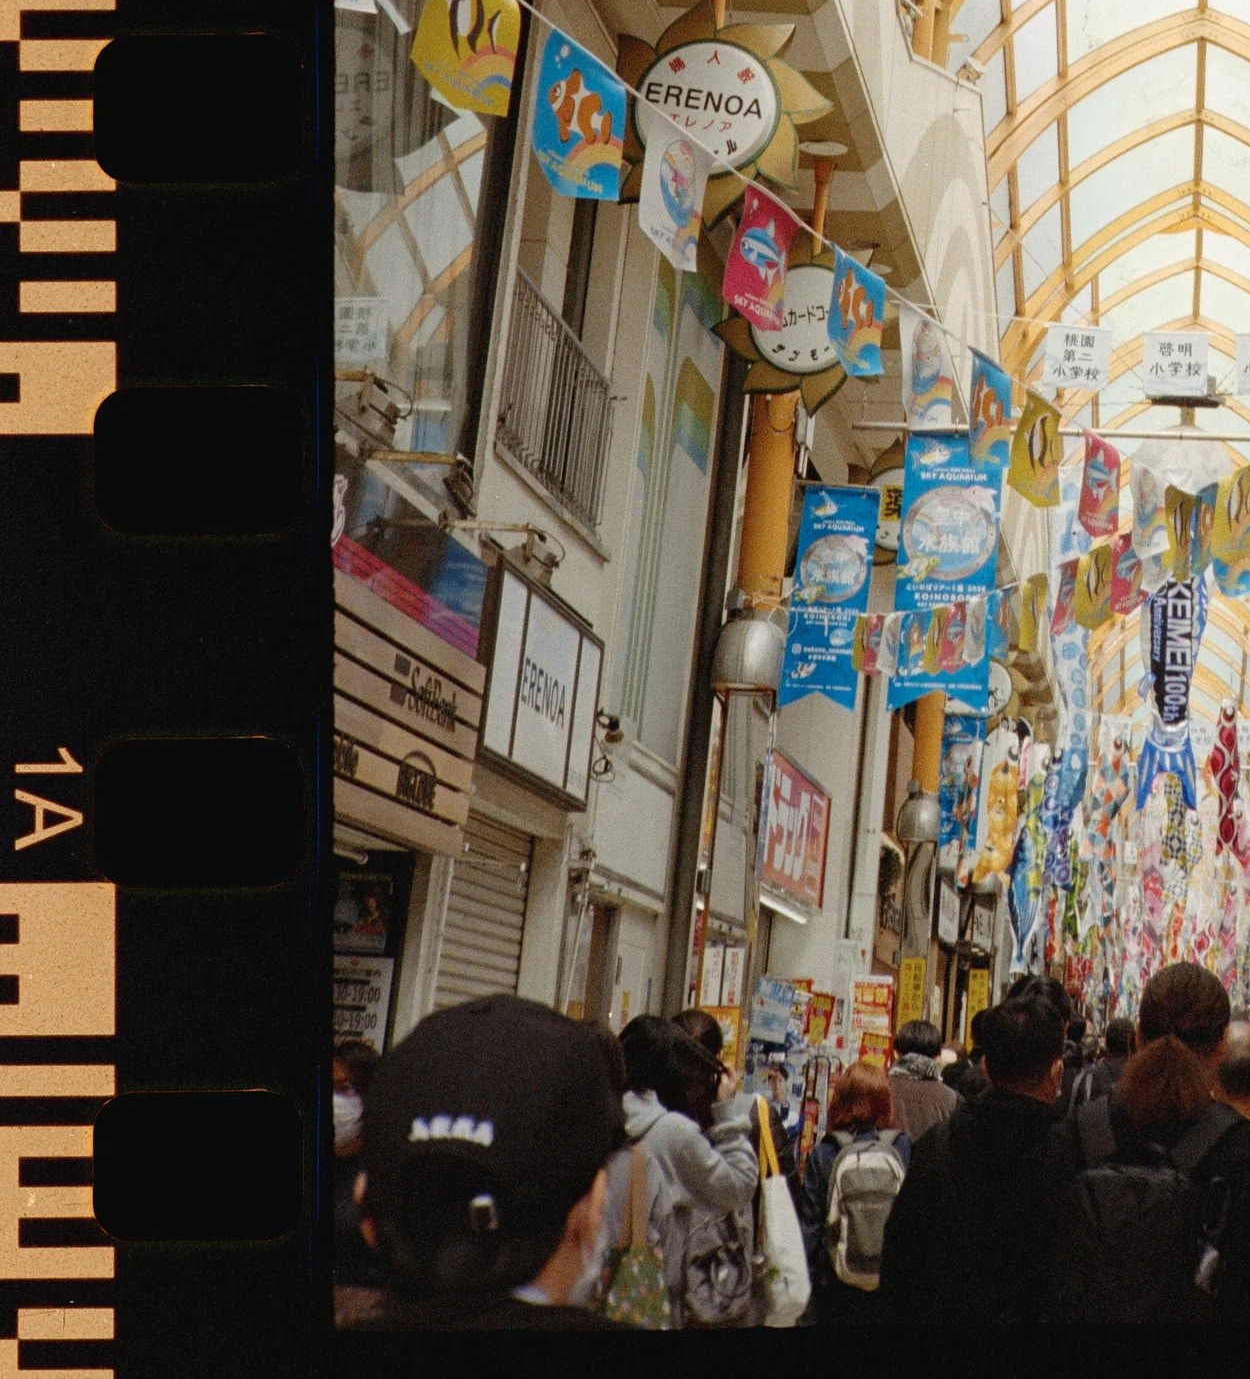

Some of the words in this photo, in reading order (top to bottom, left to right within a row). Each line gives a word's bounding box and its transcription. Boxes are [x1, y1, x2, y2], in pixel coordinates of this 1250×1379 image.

[645, 82, 763, 120] ERENOA
[1063, 333, 1095, 347] 桃園
[771, 343, 831, 361] サンモー
[1063, 349, 1094, 362] 第二
[1159, 341, 1194, 357] 啓明
[1053, 366, 1100, 381] 小学校
[1149, 360, 1202, 377] 小学校
[920, 472, 936, 481] SKY
[939, 473, 988, 482] AQUARIUM
[914, 592, 974, 602] KOINOBOR
[1165, 577, 1193, 672] KEIMEI
[520, 657, 566, 730] ERENOA
[1163, 673, 1188, 722] 100th
[15, 747, 83, 851] 1A
